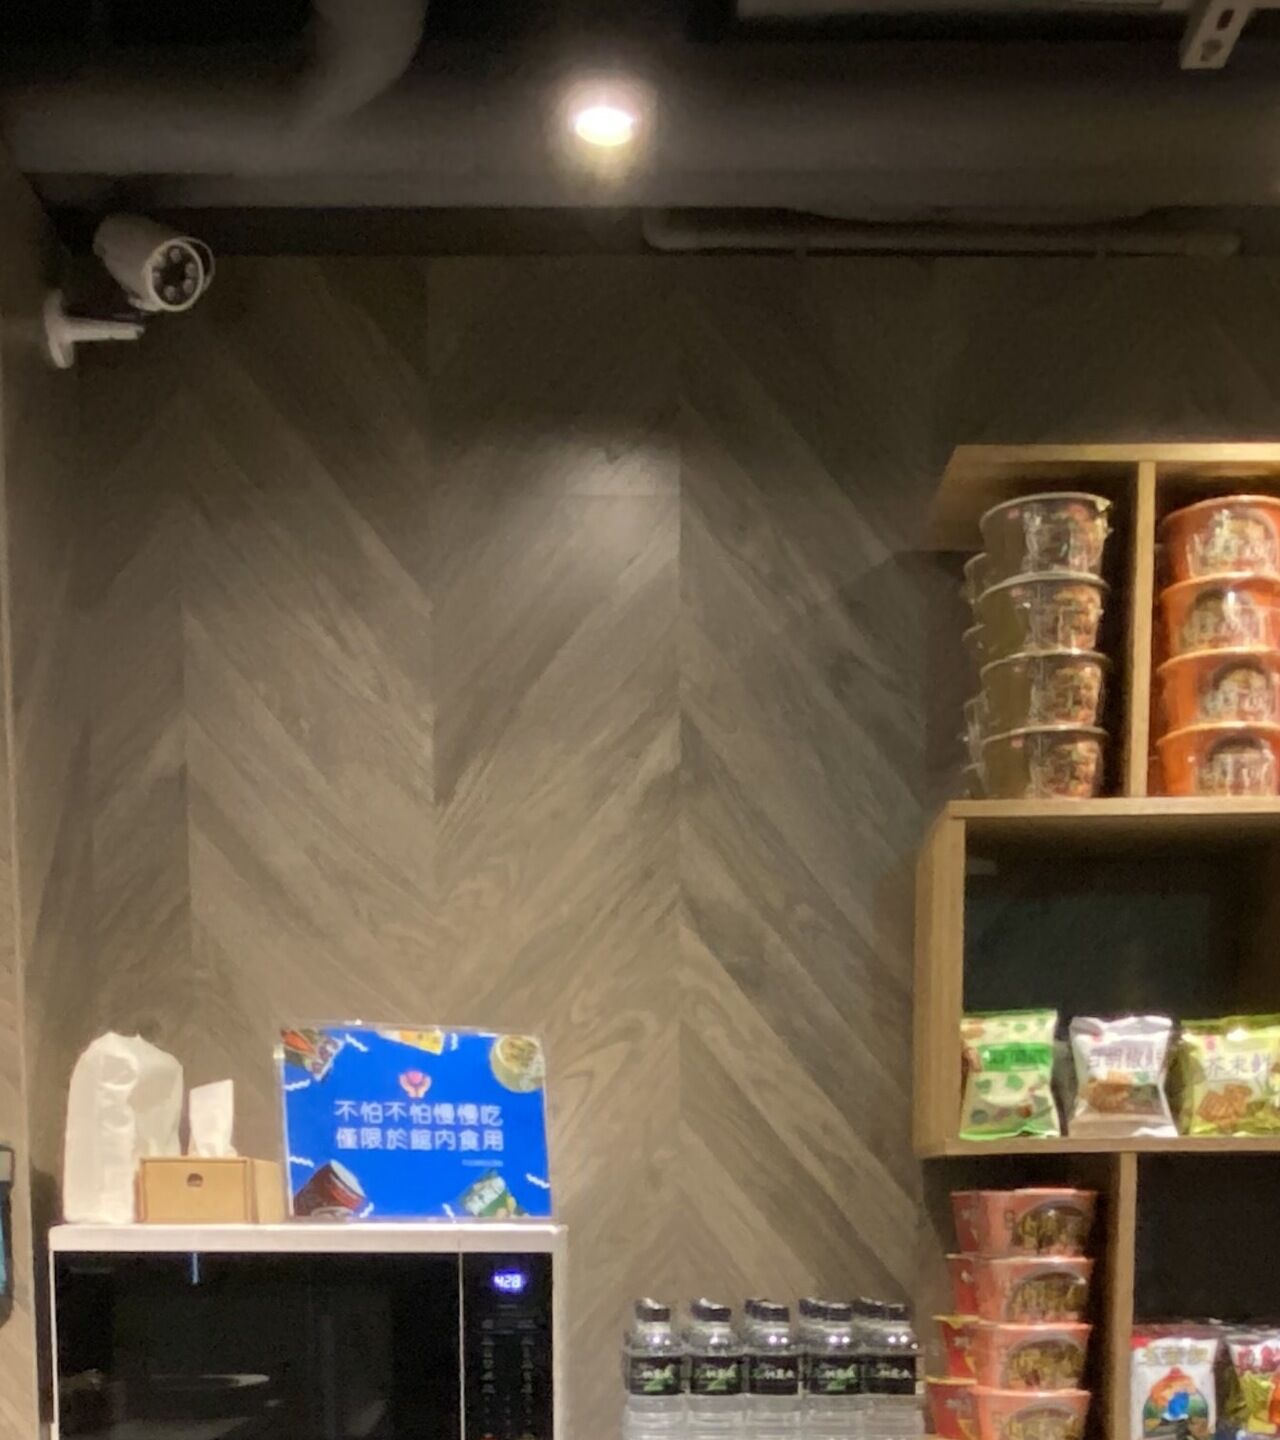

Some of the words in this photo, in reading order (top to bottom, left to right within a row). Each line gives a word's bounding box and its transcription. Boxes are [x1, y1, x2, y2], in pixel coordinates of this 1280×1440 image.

[334, 1100, 503, 1126] 不怕不怕慢慢吃
[336, 1127, 504, 1151] 僅限於館內食用
